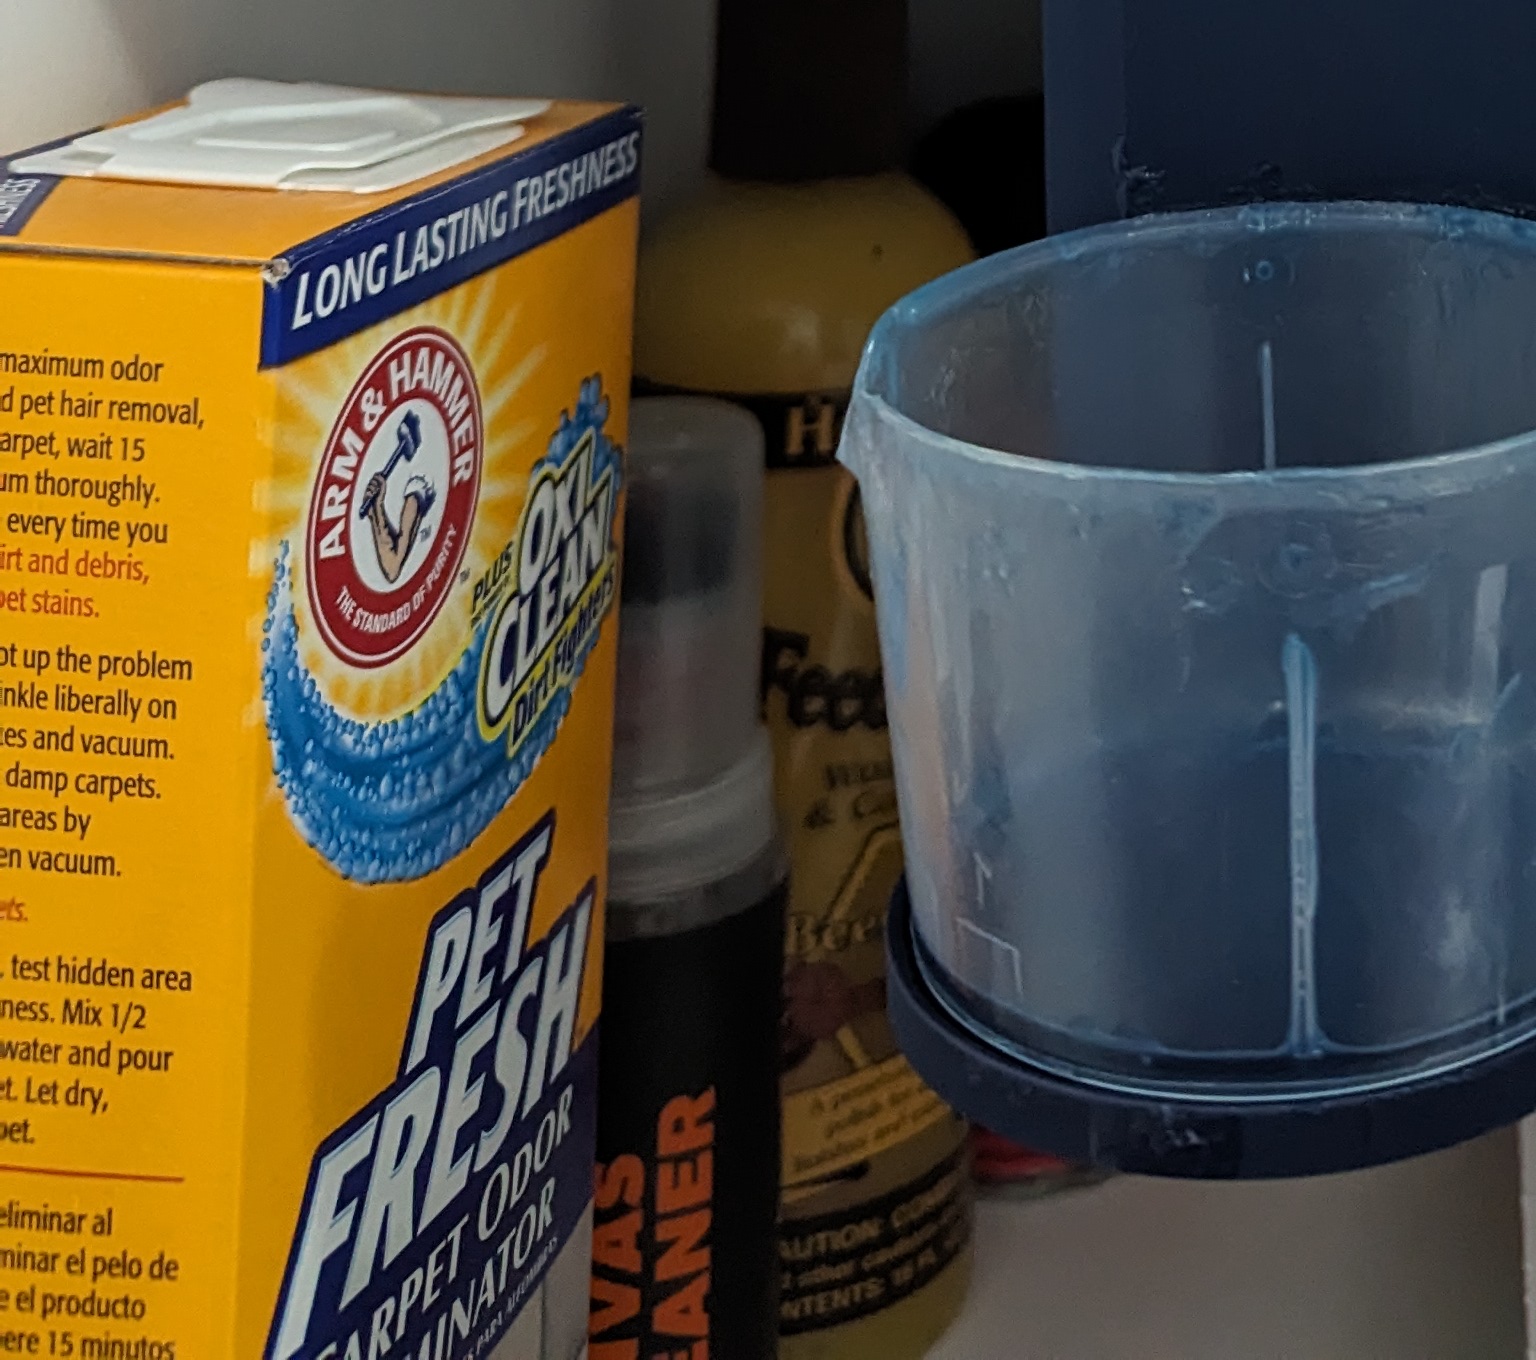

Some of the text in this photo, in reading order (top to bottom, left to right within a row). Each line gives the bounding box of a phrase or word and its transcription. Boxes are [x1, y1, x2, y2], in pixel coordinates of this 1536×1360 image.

[291, 130, 640, 330] LONG LASTING FRESHNESS
[0, 347, 164, 382] maximum odor
[20, 391, 55, 420] pet
[60, 389, 103, 419] hair
[108, 397, 204, 430] removal,
[67, 432, 113, 460] wait
[121, 436, 146, 462] 15
[320, 347, 474, 559] ARM & HAMMER
[35, 468, 160, 509] thoroughly.
[7, 510, 168, 548] every time you
[519, 437, 592, 598] OXI
[28, 548, 69, 576] and
[75, 549, 150, 585] debris,
[336, 523, 456, 634] THE STANDARD OF PURITY
[472, 541, 512, 608] PLUS
[32, 589, 100, 618] stains.
[487, 480, 611, 720] CLEAN
[23, 648, 50, 677] up
[56, 644, 92, 674] the
[98, 649, 193, 681] problem
[54, 684, 143, 723] liberally
[148, 698, 177, 720] on
[33, 725, 75, 752] and
[80, 733, 175, 760] vacuum.
[6, 760, 161, 803] damp carpets.
[0, 805, 91, 841] areas by
[28, 849, 122, 877] vacuum.
[405, 824, 551, 1076] PET
[11, 954, 192, 991] test hidden area
[61, 998, 102, 1027] Mix
[111, 1001, 147, 1035] 1/2
[0, 1037, 174, 1076] water and pour
[25, 1076, 59, 1105] Let
[65, 1078, 109, 1115] dry,
[272, 894, 594, 1360] FRESH
[478, 1083, 573, 1241] ODOR
[92, 1207, 113, 1236] al
[66, 1247, 85, 1276] el
[93, 1248, 143, 1283] pelo
[149, 1249, 179, 1280] de
[16, 1283, 36, 1312] el
[42, 1288, 146, 1321] producto
[49, 1330, 74, 1357] 15
[81, 1331, 176, 1360] minutos
